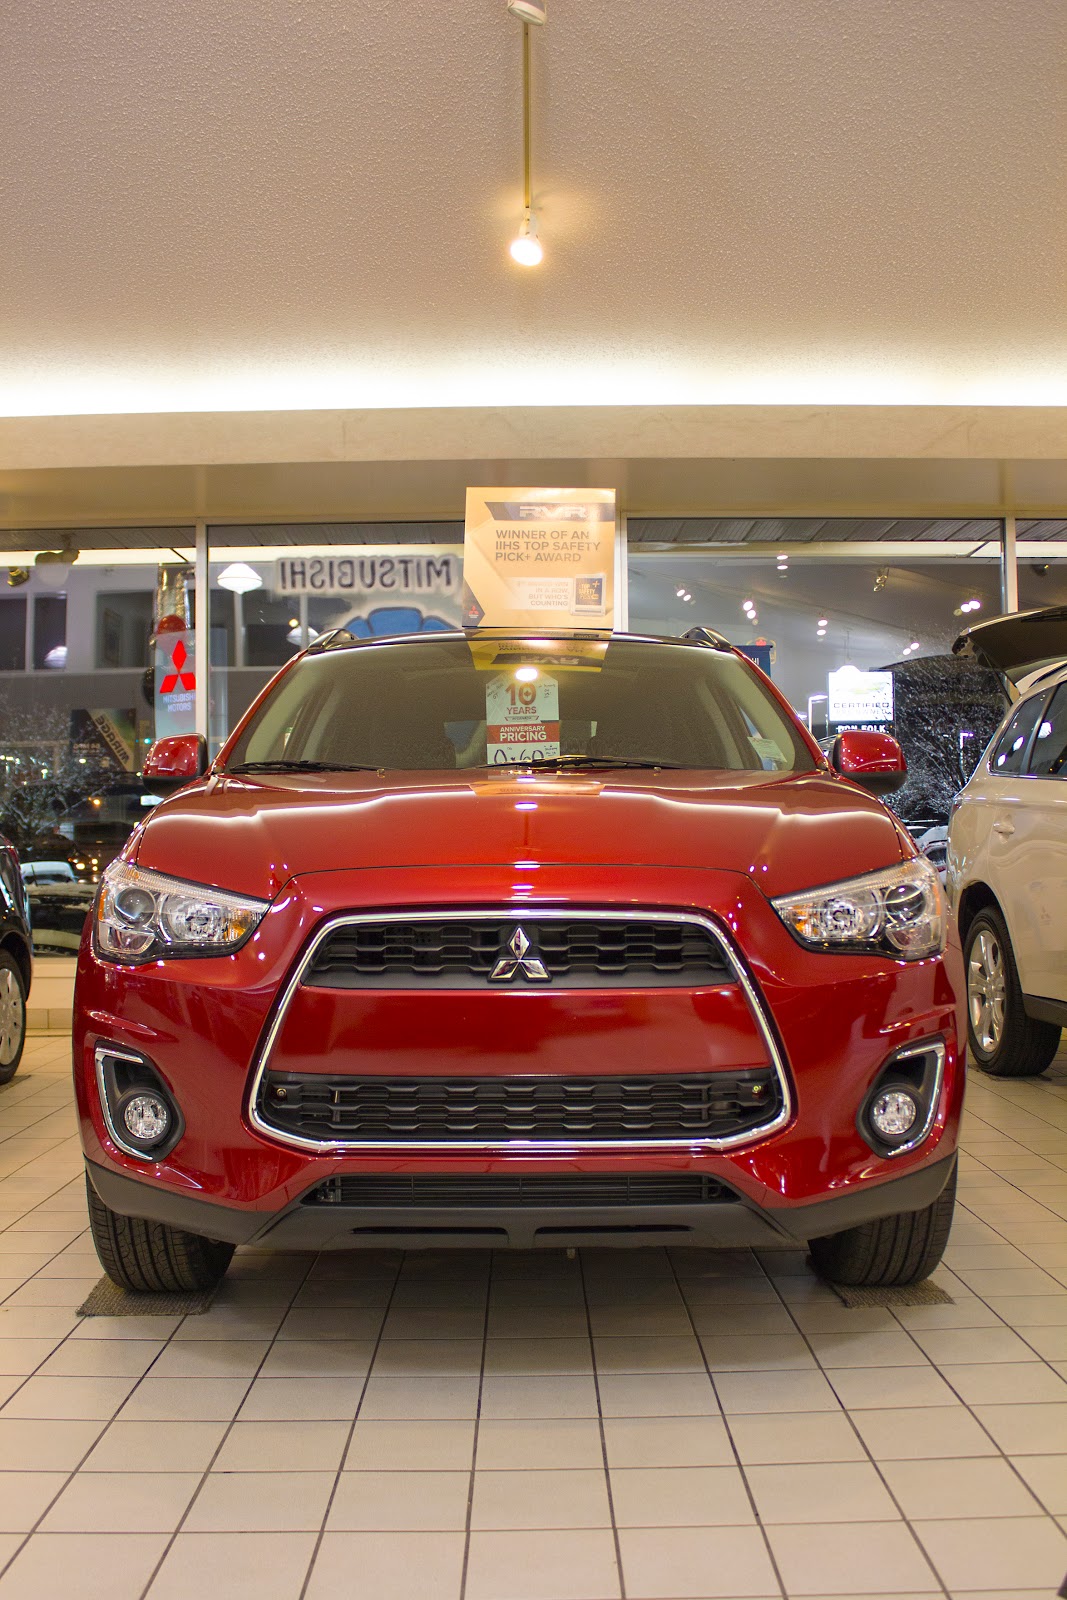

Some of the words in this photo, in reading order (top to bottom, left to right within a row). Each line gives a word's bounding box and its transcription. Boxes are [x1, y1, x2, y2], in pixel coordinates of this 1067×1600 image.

[519, 505, 587, 518] RVR
[495, 529, 546, 540] WINNER
[550, 530, 568, 540] OF
[571, 530, 590, 540] AN
[495, 541, 520, 551] IIHS
[523, 541, 550, 551] TOP
[553, 541, 601, 551] SAFETY
[495, 552, 531, 562] PICK+
[534, 552, 582, 562] AWARD
[504, 682, 537, 706] 10
[167, 701, 192, 713] MOTORS
[506, 706, 537, 715] YEARS
[500, 725, 546, 733] ANNIVERSARY
[500, 731, 547, 742] PRICING
